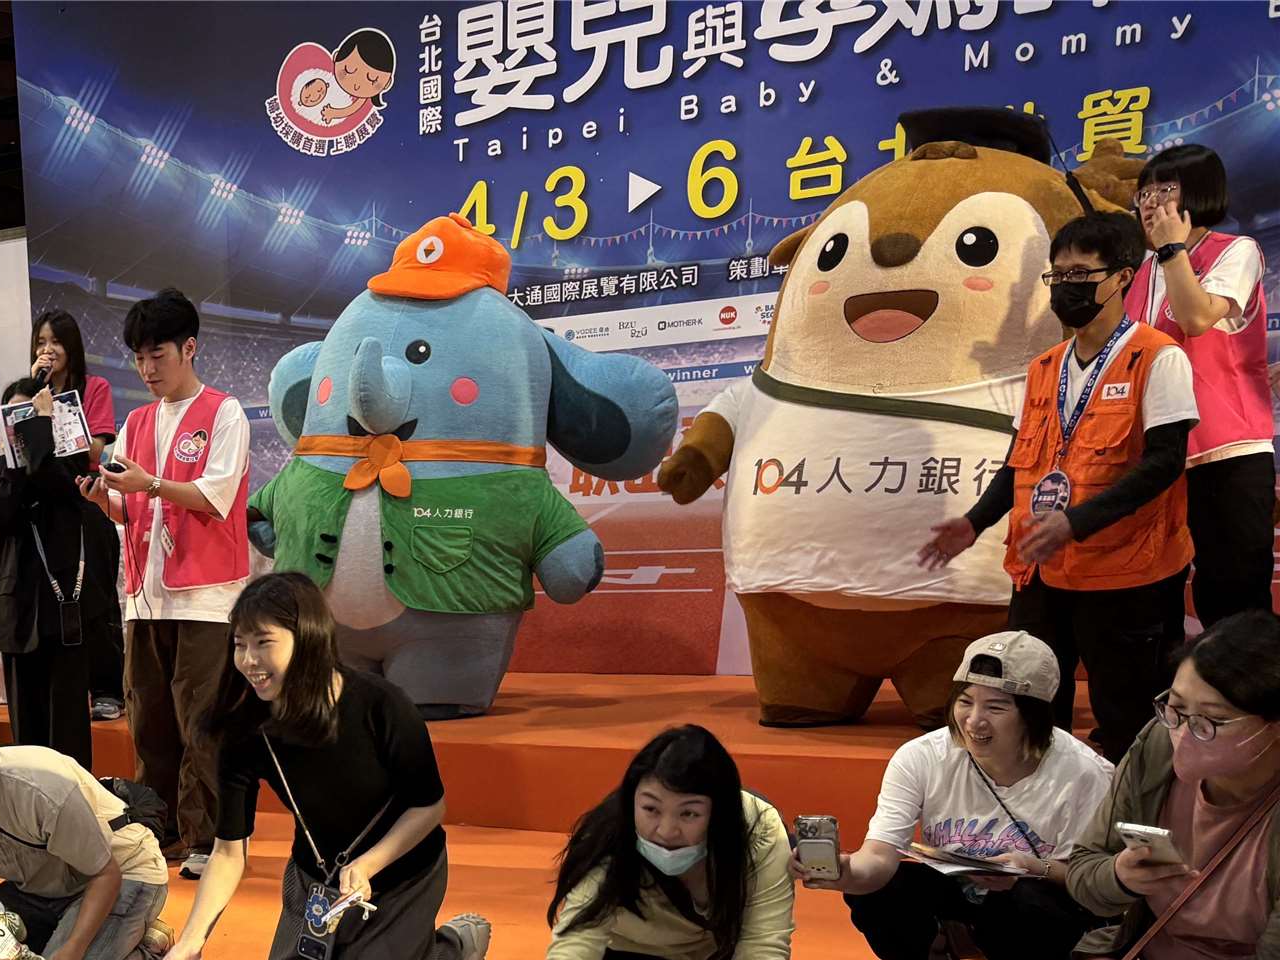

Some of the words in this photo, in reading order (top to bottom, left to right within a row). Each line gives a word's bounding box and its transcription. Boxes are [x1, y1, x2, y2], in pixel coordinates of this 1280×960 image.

[419, 14, 442, 135] 台北國際
[453, 107, 626, 162] Taipei
[680, 79, 816, 120] Baby
[876, 57, 900, 86] &
[964, 13, 1192, 72] Mommy
[330, 112, 383, 155] 上聯展覽
[687, 139, 739, 219] 6
[720, 310, 736, 320] NUK
[413, 507, 474, 519] 104人力銀行
